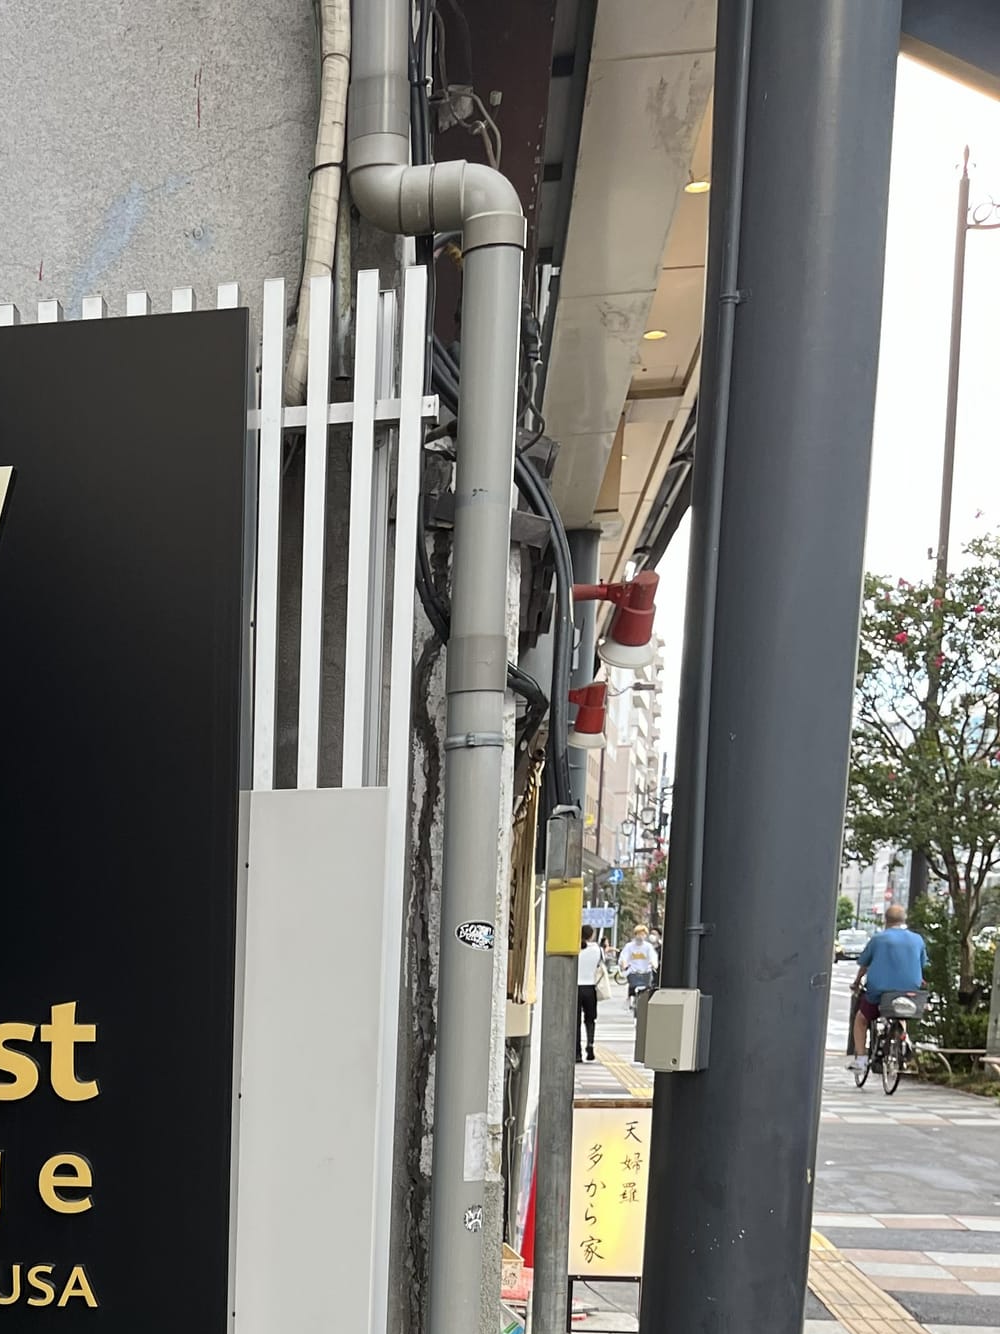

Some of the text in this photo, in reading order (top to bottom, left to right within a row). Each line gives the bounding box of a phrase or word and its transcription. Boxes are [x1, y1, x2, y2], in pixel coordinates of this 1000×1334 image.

[579, 1143, 606, 1264] 多から家
[619, 1120, 643, 1204] 天婦羅
